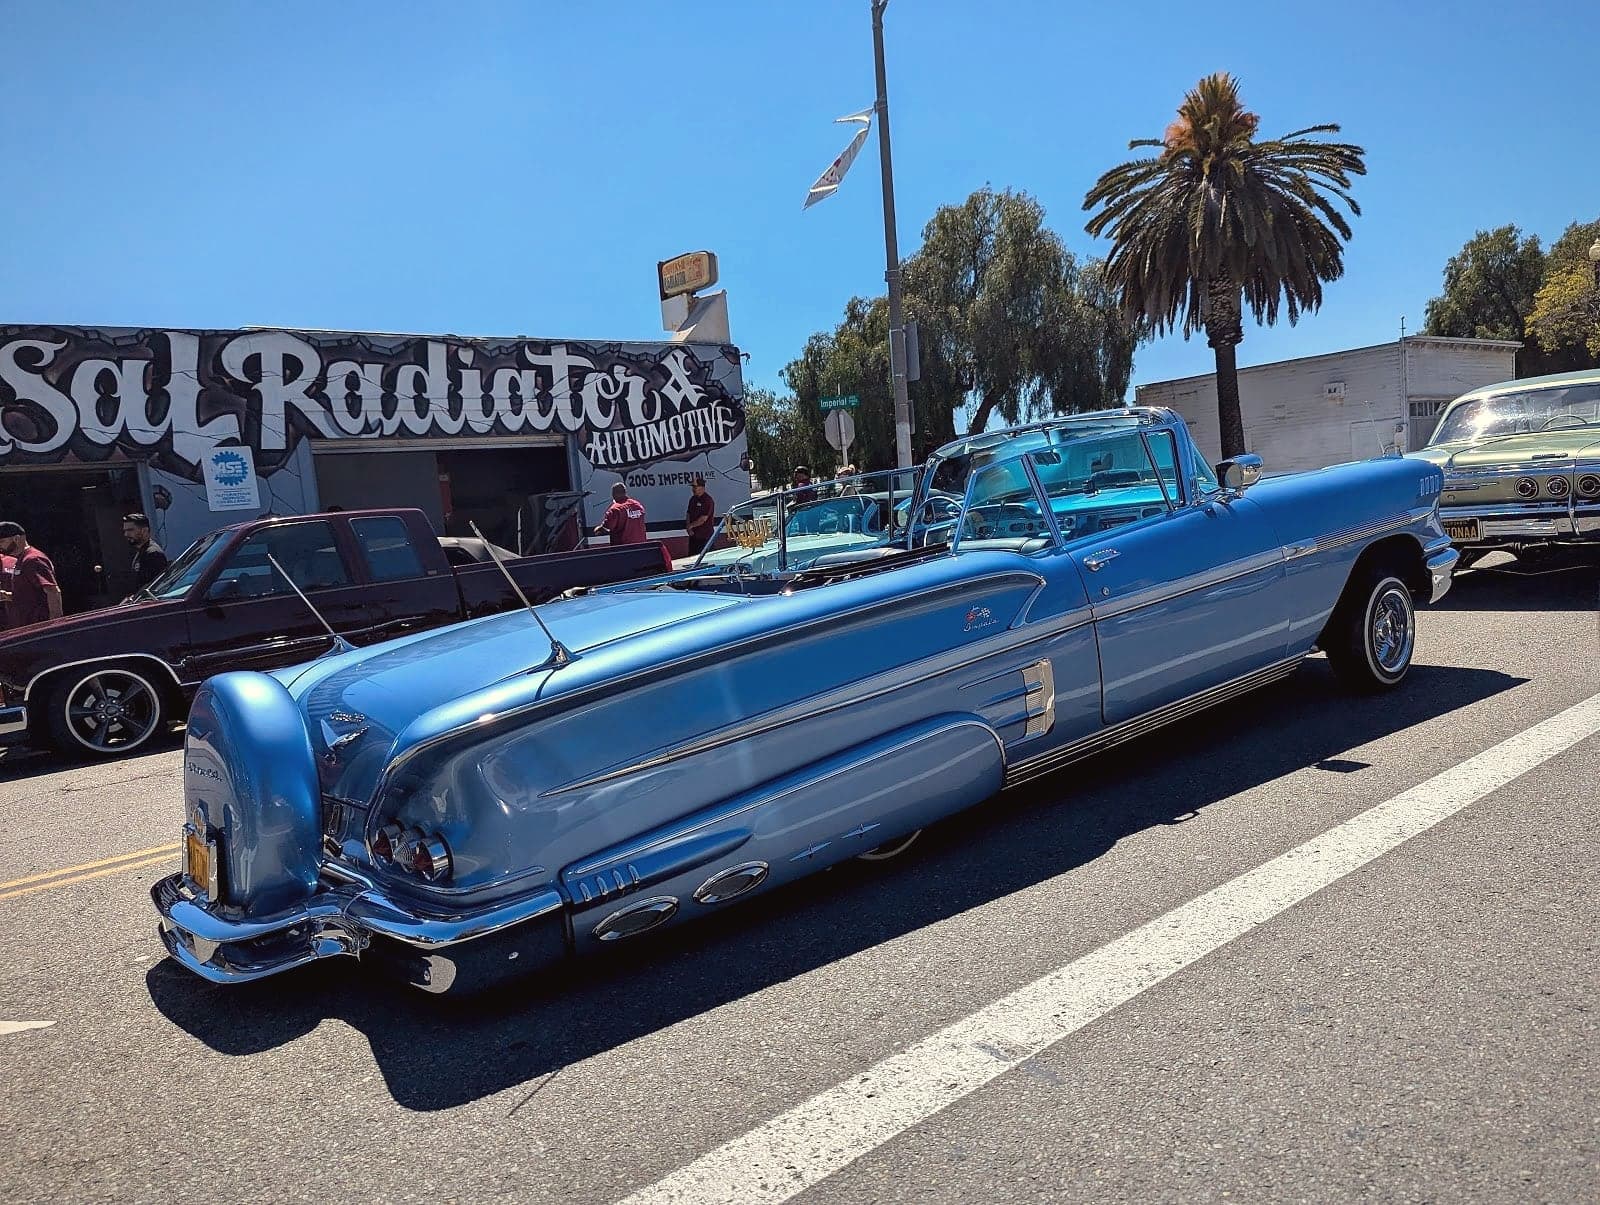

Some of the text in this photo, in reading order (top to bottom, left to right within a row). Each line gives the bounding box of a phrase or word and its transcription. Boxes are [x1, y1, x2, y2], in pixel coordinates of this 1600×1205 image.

[221, 330, 662, 449] Radiator
[820, 397, 847, 409] Imperial
[585, 400, 737, 466] AUTOMOTIVE
[628, 473, 656, 487] 2005
